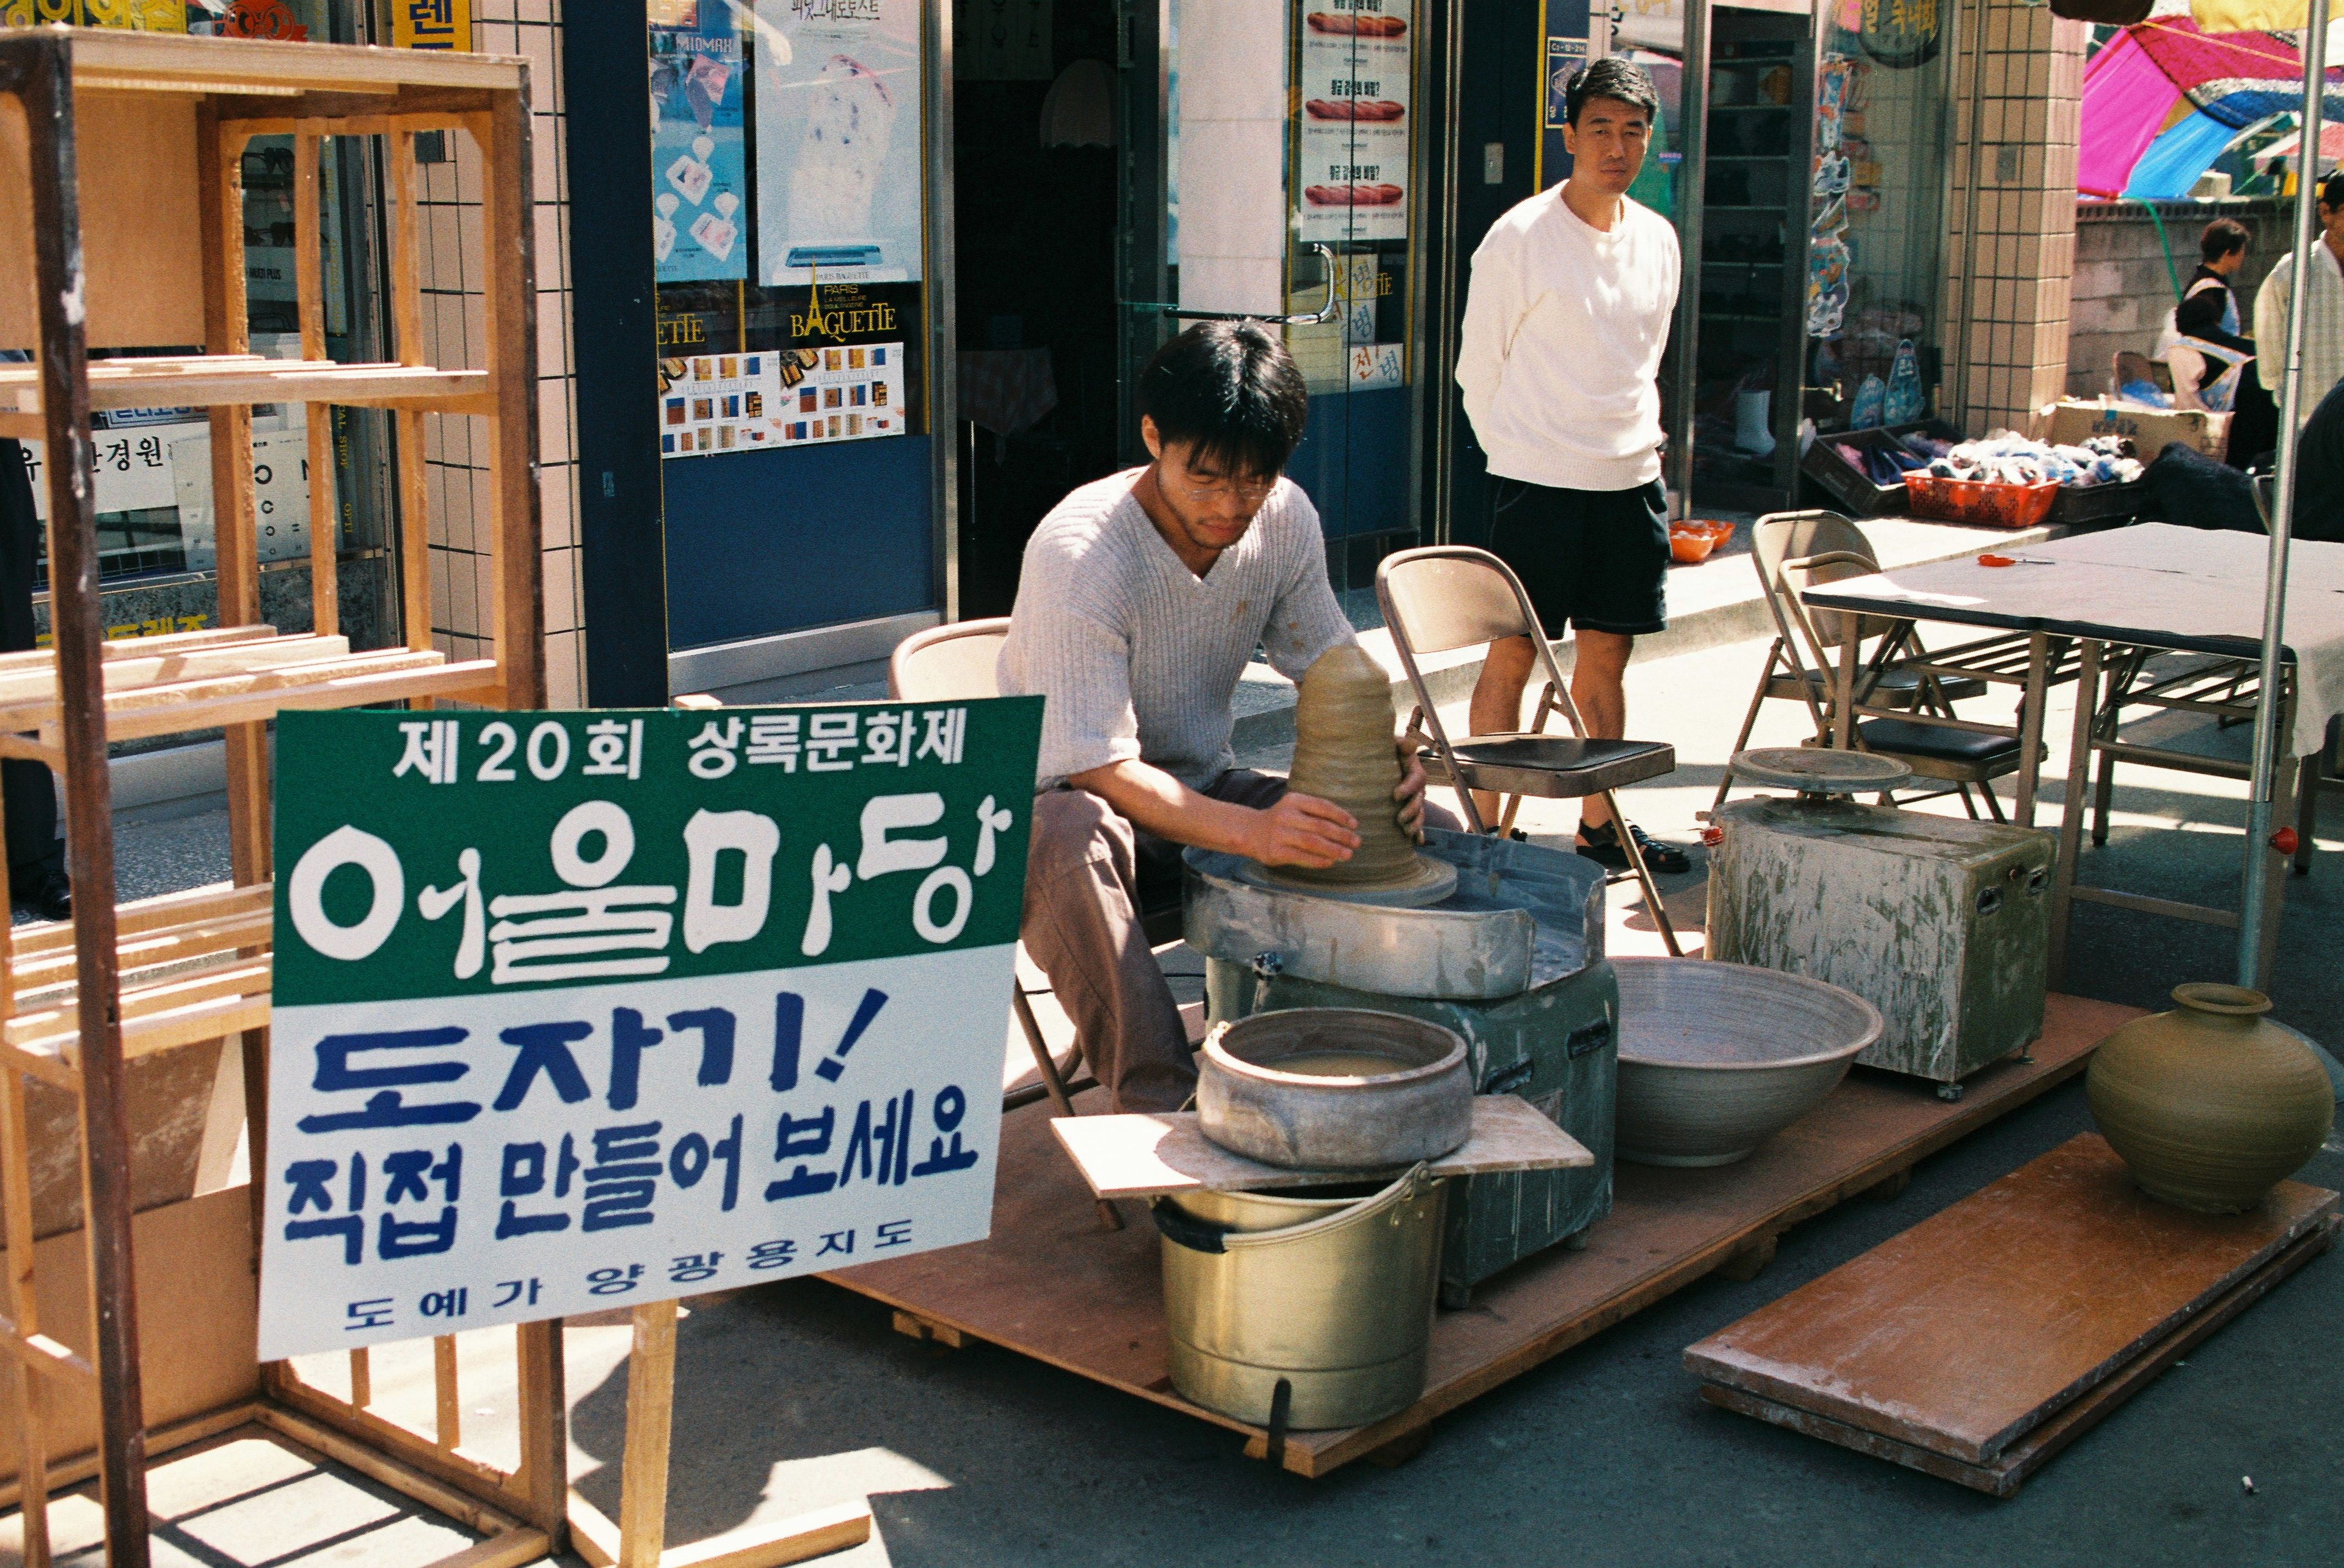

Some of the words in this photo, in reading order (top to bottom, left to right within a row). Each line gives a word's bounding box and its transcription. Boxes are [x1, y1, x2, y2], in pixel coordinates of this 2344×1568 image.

[790, 298, 897, 343] BAGUETTE
[687, 707, 968, 779] 상록문화제
[289, 791, 1012, 985] 어울마당
[296, 988, 889, 1134] 도자기!
[284, 1141, 463, 1266] 직접
[495, 1113, 744, 1240] 만들어
[764, 1084, 979, 1202] 보세요
